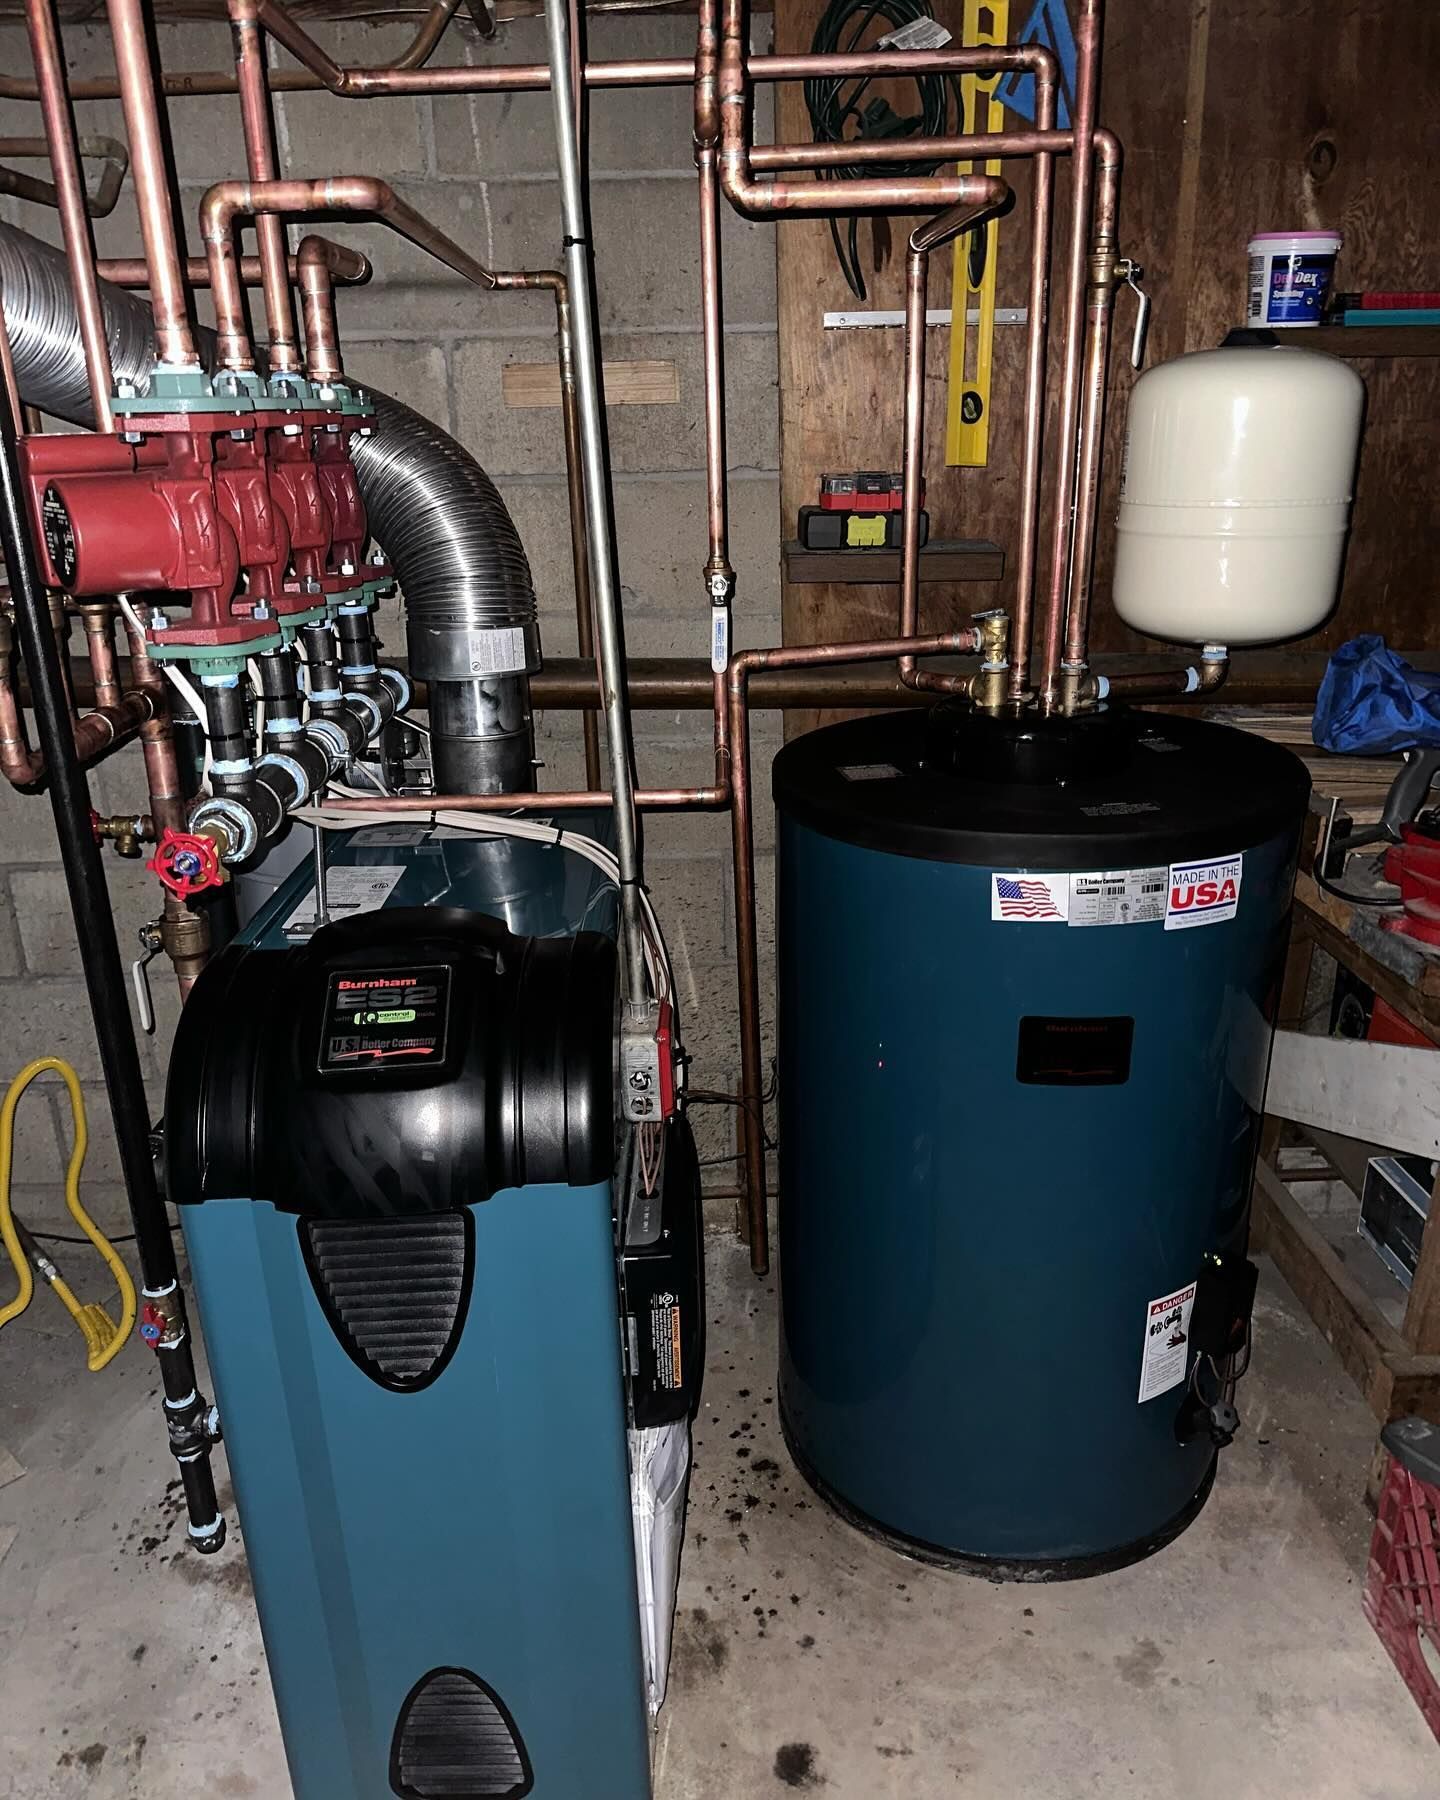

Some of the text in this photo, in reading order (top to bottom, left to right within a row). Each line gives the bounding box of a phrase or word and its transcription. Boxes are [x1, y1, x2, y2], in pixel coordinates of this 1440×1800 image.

[1173, 870, 1205, 886] MADE
[1208, 869, 1218, 880] IN
[1221, 864, 1240, 878] THE
[1171, 879, 1236, 910] USA
[338, 979, 417, 990] Burnham
[336, 986, 438, 1009] ES2
[391, 1036, 437, 1048] Company
[1162, 1289, 1193, 1311] DANGER
